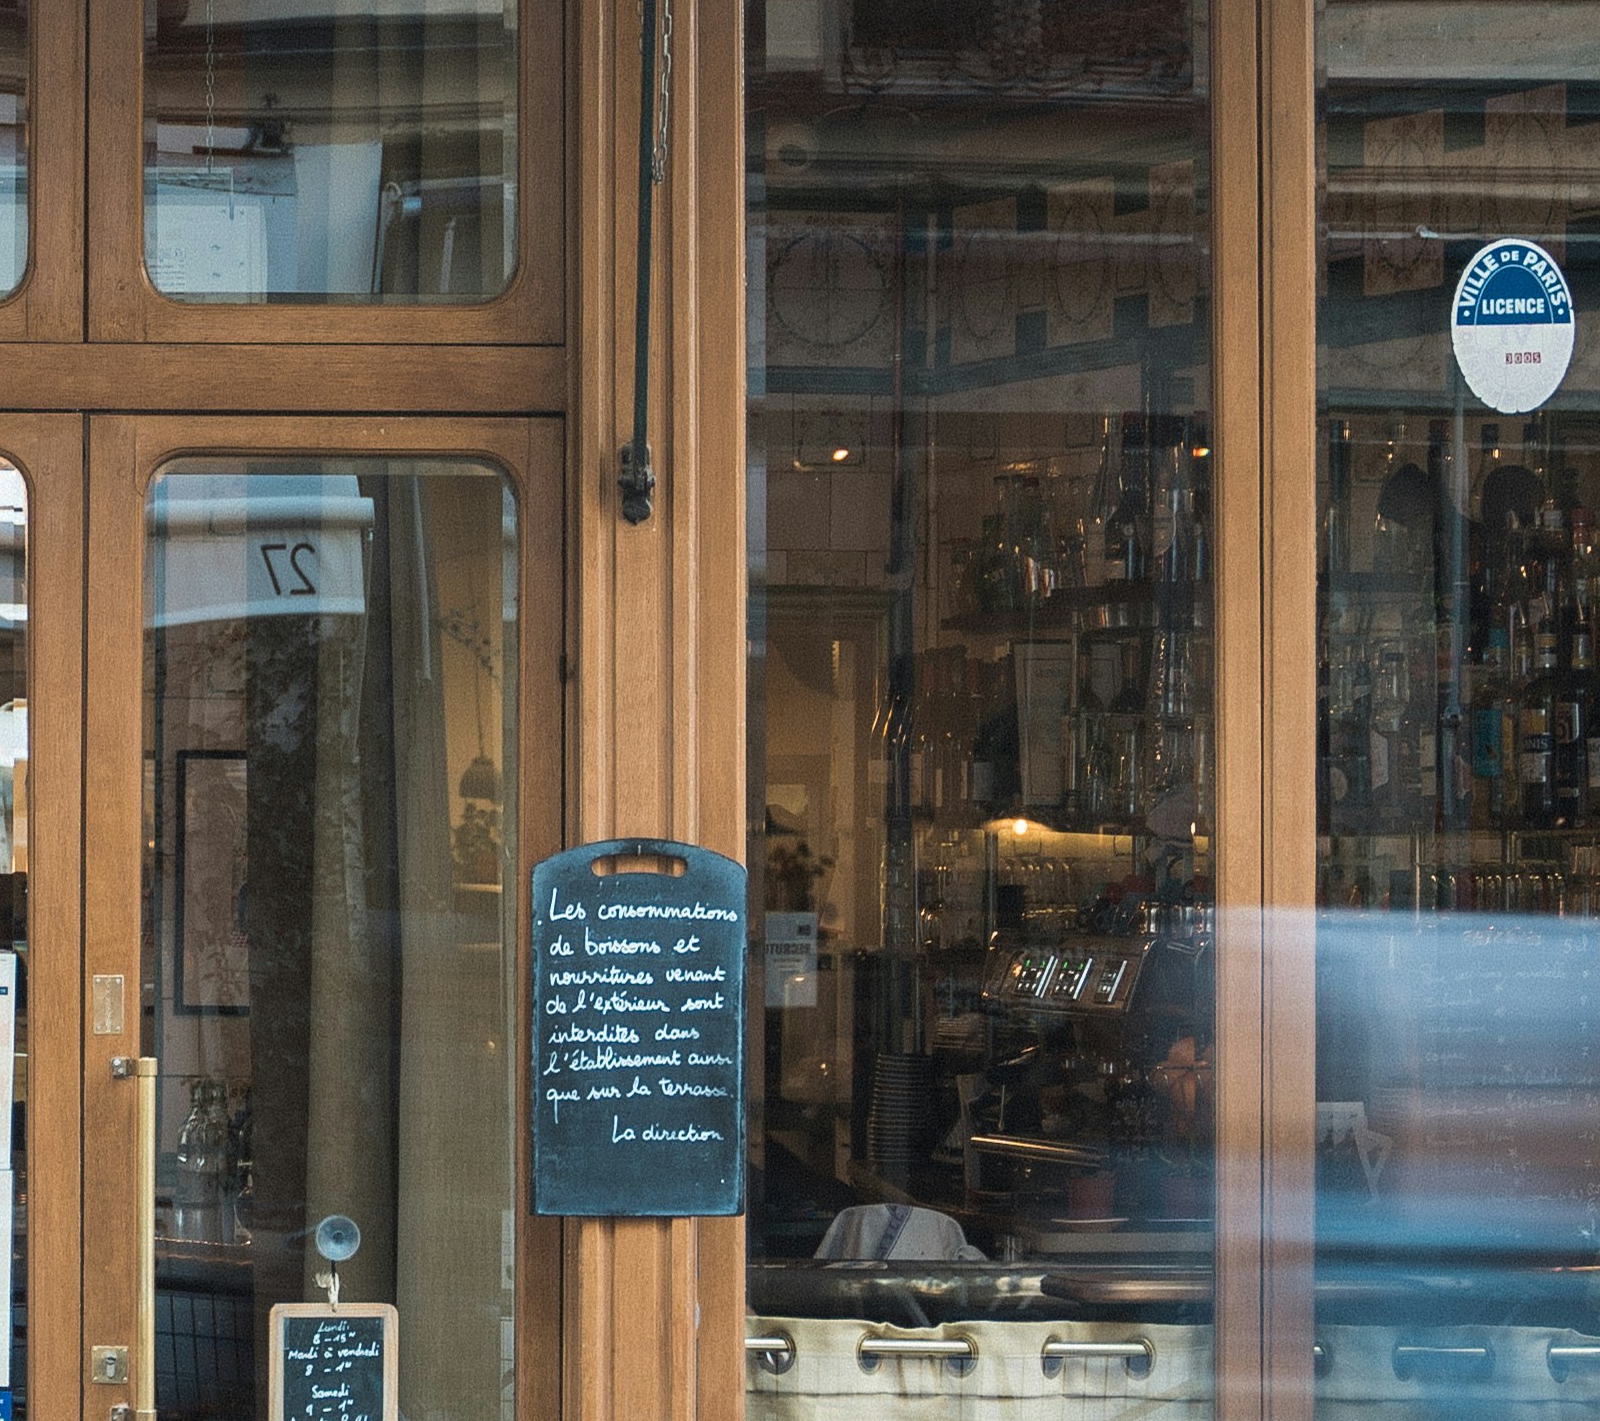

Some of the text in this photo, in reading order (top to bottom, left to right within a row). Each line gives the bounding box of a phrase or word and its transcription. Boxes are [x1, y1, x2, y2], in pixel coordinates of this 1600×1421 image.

[1458, 250, 1567, 308] VILLE DE PARIS
[1482, 297, 1545, 315] LICENCE
[1505, 352, 1541, 364] 3005
[550, 888, 738, 923] Les consommations
[550, 927, 700, 956] de boissons et
[550, 967, 726, 986] nourritures venant
[546, 990, 724, 1015] de l'extérieur sont
[549, 1023, 700, 1046] interdites dans
[544, 1044, 733, 1076] l'établissement ainsi
[546, 1088, 580, 1123] que
[587, 1084, 621, 1101] sur
[630, 1077, 651, 1096] la
[613, 1115, 724, 1143] La direction
[324, 1347, 333, 1358] à
[338, 1341, 379, 1358] vendredi
[312, 1383, 350, 1398] Samedi
